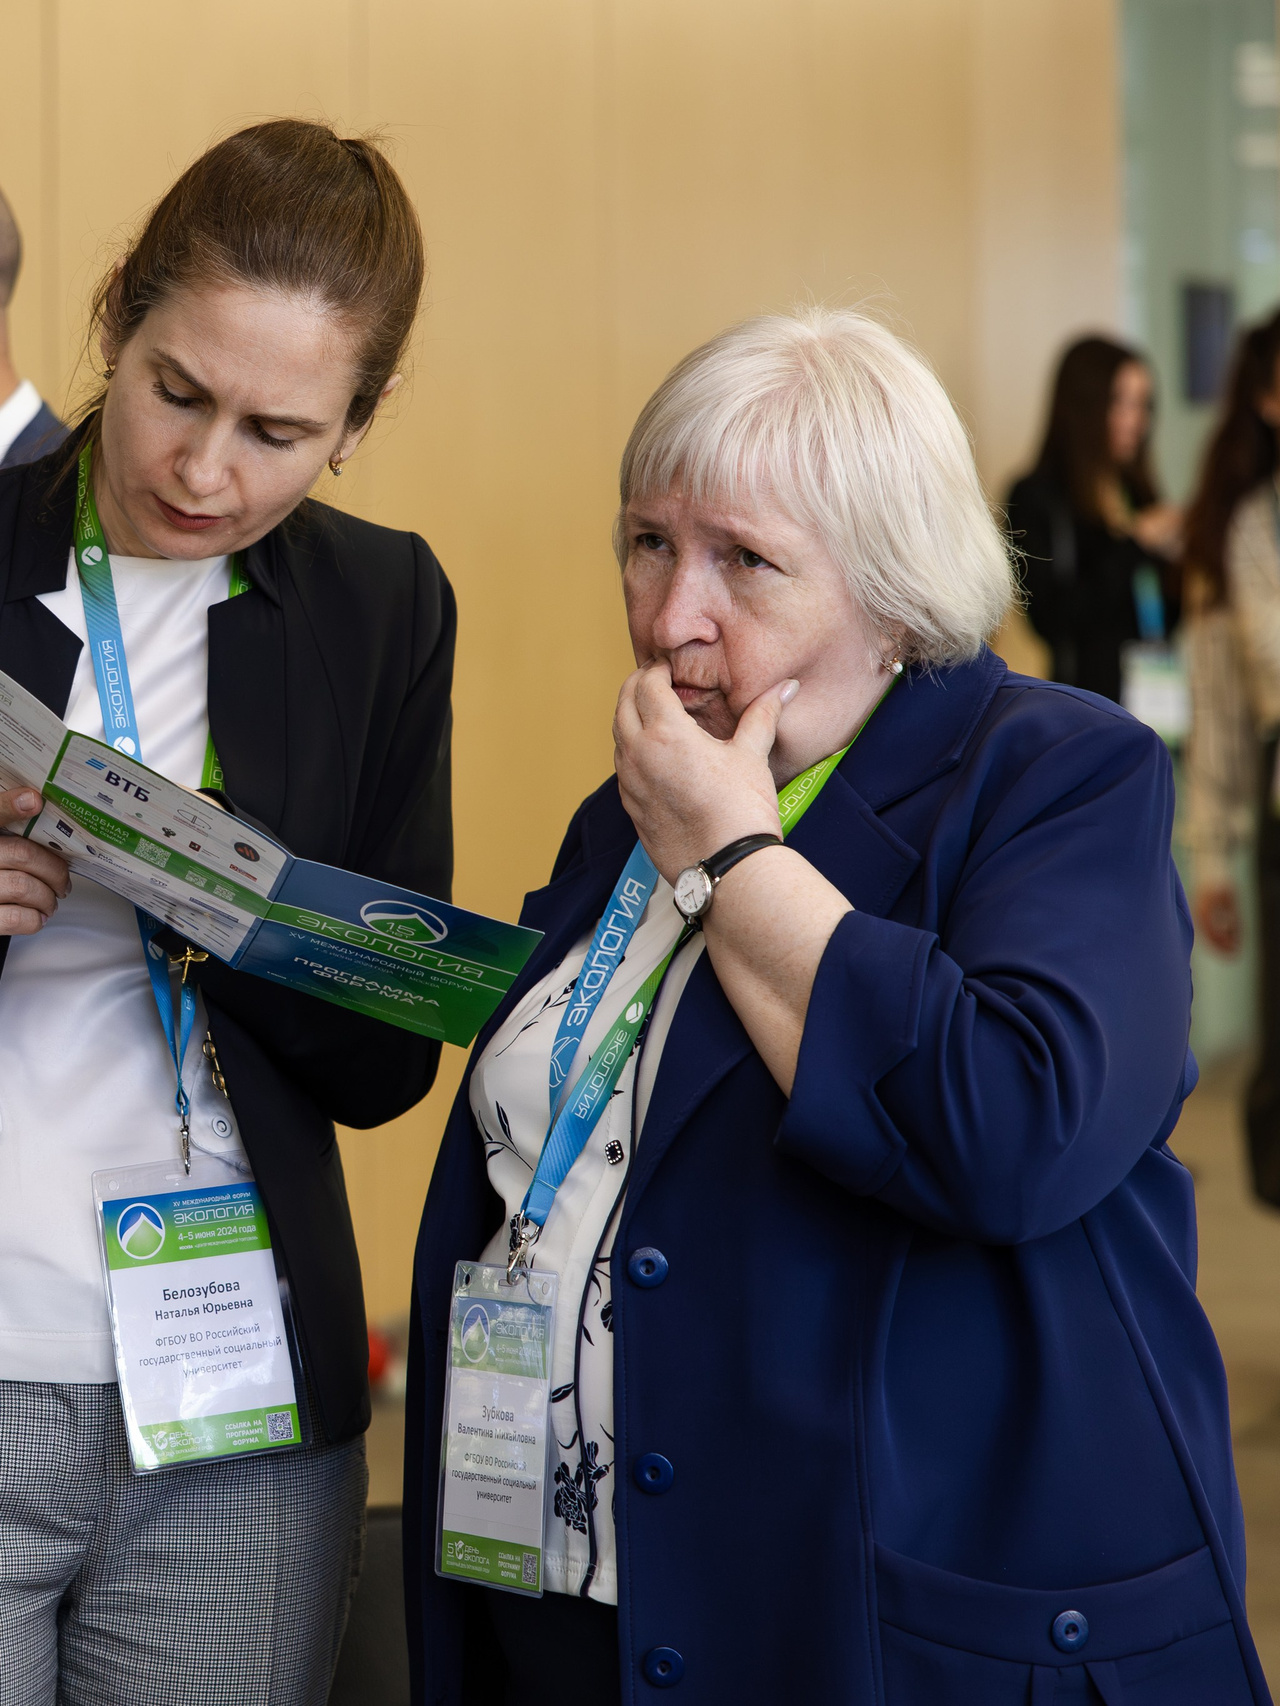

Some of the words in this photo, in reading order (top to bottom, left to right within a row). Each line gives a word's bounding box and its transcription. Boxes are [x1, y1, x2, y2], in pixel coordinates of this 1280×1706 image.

[102, 640, 126, 729] ЭКОЛОГИЯ
[105, 770, 151, 803] ВТБ
[61, 797, 130, 838] ПОДРОБНАЯ
[387, 922, 416, 936] 15
[296, 915, 484, 979] ЭКОЛОГИЯ
[566, 877, 647, 1026] ЭКОЛОГИЯ
[289, 931, 305, 940] XV
[310, 938, 425, 977] МЕЖДУНАРОДНЫЙ
[430, 975, 473, 992] ФОРУМ
[294, 957, 440, 1007] ПРОГРАММА
[313, 969, 415, 1006] ФОРУМА
[574, 1030, 628, 1119] ЭКОЛОГИЯ
[182, 1193, 231, 1206] МЕЖДУНАРОДНЫЙ
[173, 1204, 255, 1224] ЭКОЛОГИЯ
[195, 1230, 216, 1240] июня
[216, 1225, 238, 1237] 2024
[238, 1225, 257, 1234] года
[162, 1281, 241, 1301] Белозубова
[155, 1307, 200, 1321] Наталья
[202, 1298, 254, 1314] Юрьевна
[155, 1334, 187, 1347] ФГБОУ
[189, 1331, 203, 1342] ВО
[205, 1323, 261, 1340] Российский
[139, 1346, 221, 1367] государственный
[223, 1336, 283, 1354] социальный
[183, 1360, 243, 1378] университет
[482, 1405, 514, 1422] Зубкова
[224, 1421, 252, 1431] ССЫЛКА
[253, 1419, 263, 1427] НА
[225, 1427, 264, 1439] ПРОГРАММУ
[458, 1423, 493, 1439] Валентина
[495, 1428, 536, 1445] Михайловна
[170, 1432, 193, 1441] ДЕНЬ
[170, 1437, 213, 1448] ЭКОЛОГА
[232, 1437, 259, 1446] ФОРУМА
[464, 1452, 485, 1465] ФГБОУ
[485, 1455, 493, 1466] ВО
[452, 1469, 501, 1484] государственный
[502, 1477, 537, 1490] социальный
[477, 1490, 512, 1504] университет
[447, 1542, 454, 1554] 5
[464, 1554, 490, 1565] ЭКОЛОГА
